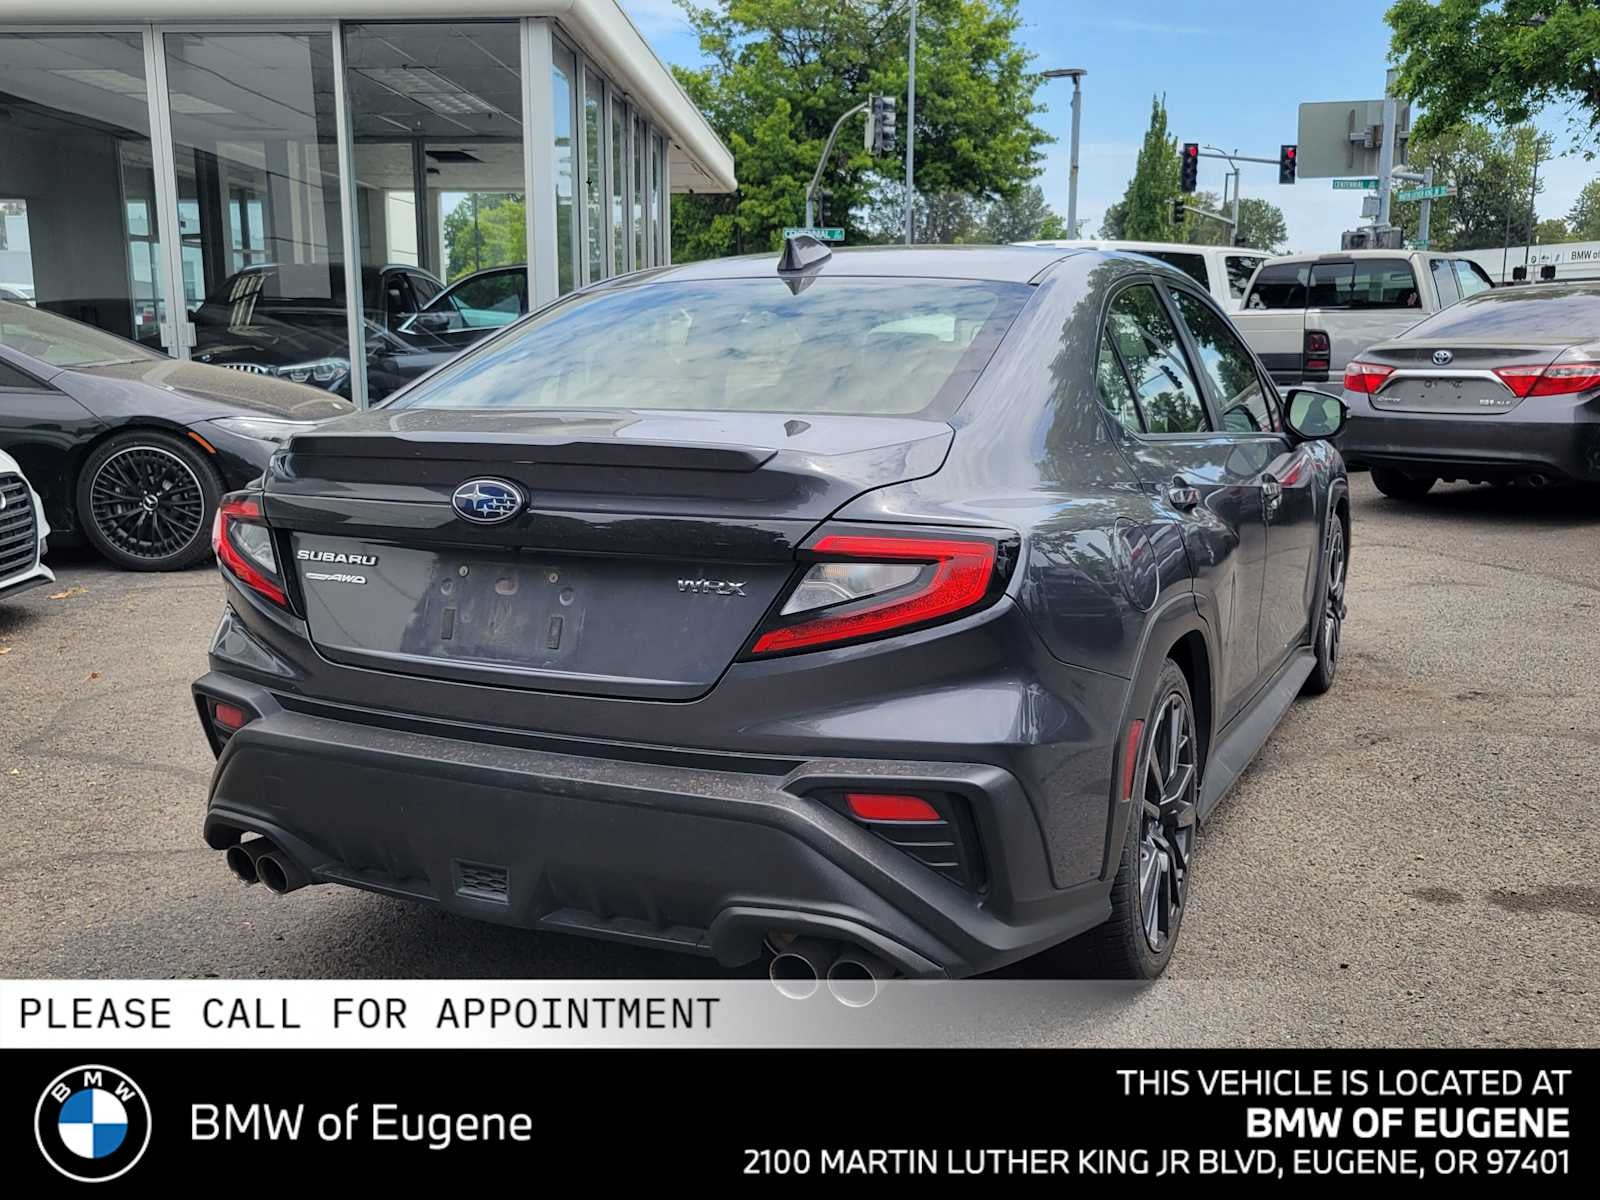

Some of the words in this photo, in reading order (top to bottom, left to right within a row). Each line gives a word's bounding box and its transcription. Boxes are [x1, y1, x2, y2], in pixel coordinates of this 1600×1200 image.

[1570, 250, 1592, 260] BMW
[297, 550, 378, 566] SUBARU
[678, 579, 746, 596] WRX
